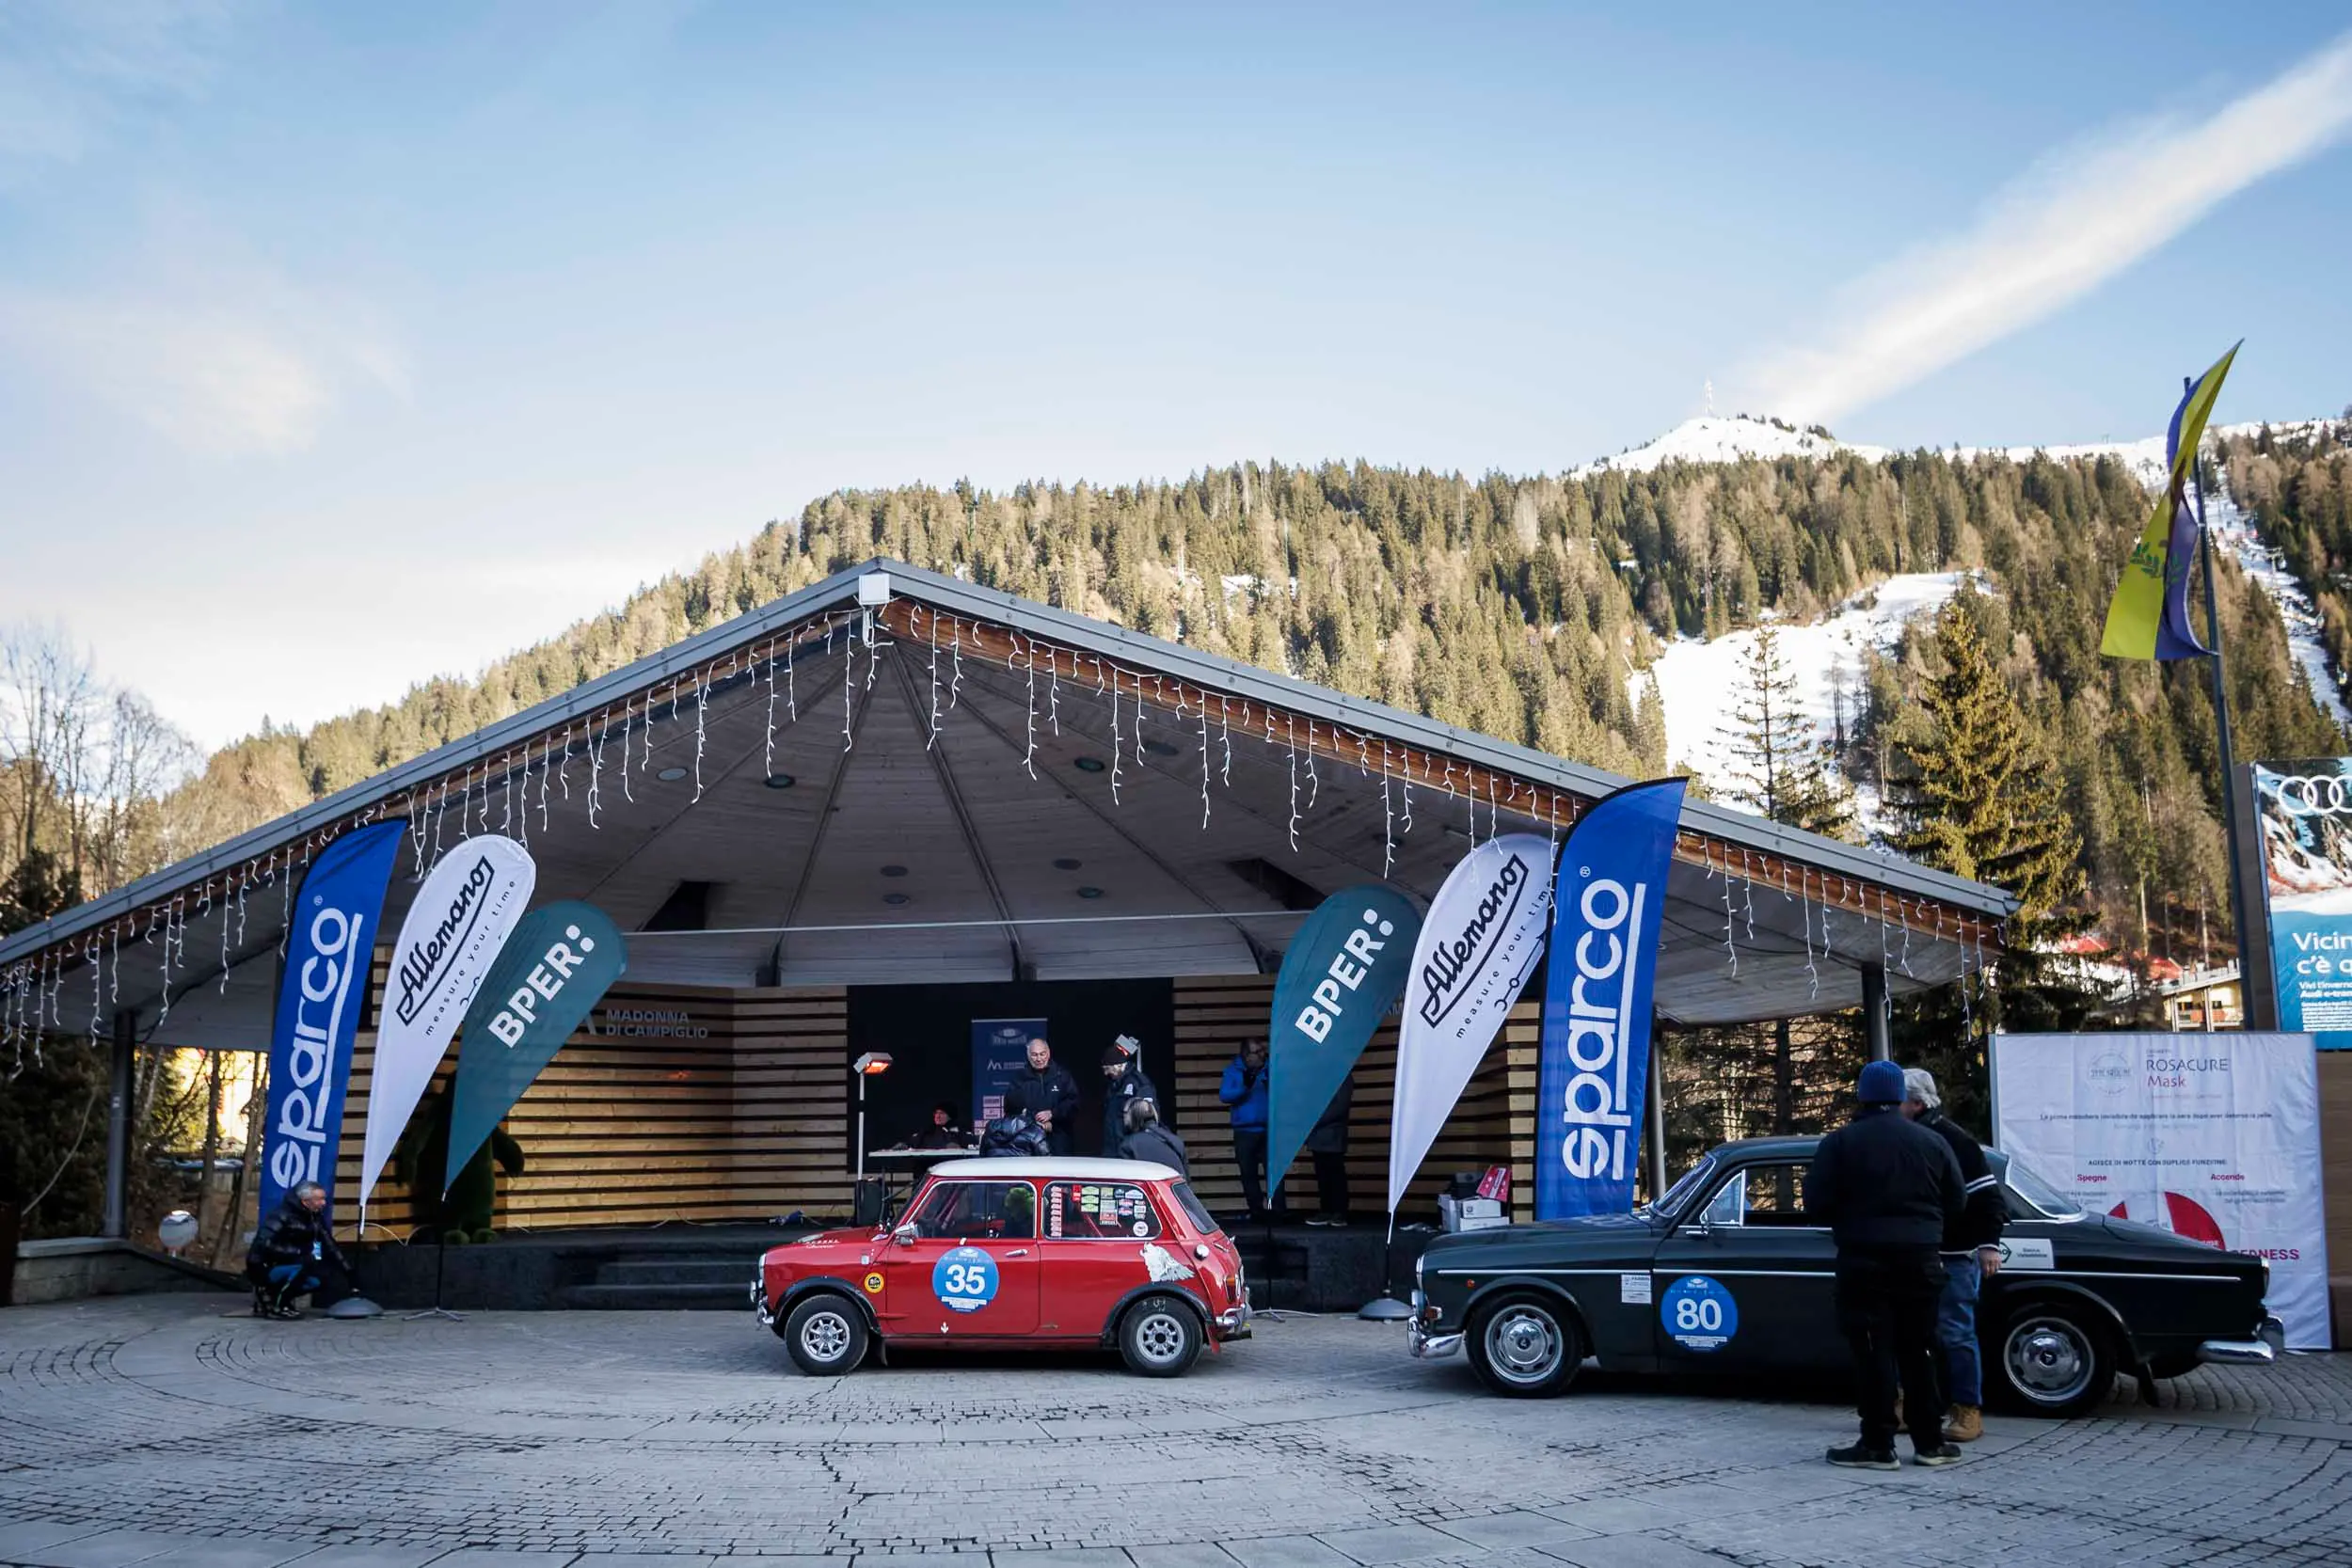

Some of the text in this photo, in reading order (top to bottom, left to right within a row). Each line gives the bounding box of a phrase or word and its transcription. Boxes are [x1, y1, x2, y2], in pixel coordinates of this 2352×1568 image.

[425, 880, 516, 1036] measure your time
[1456, 970, 1500, 1038] measure
[1501, 926, 1526, 962] your
[605, 1008, 690, 1024] MADONNA
[605, 1023, 708, 1039] DI CAMPIGLIO
[2146, 1058, 2229, 1072] ROSACURE
[2147, 1075, 2186, 1088] Mask
[2076, 1173, 2107, 1183] Spegne
[945, 1263, 986, 1295] 35
[1677, 1298, 1723, 1331] 80
